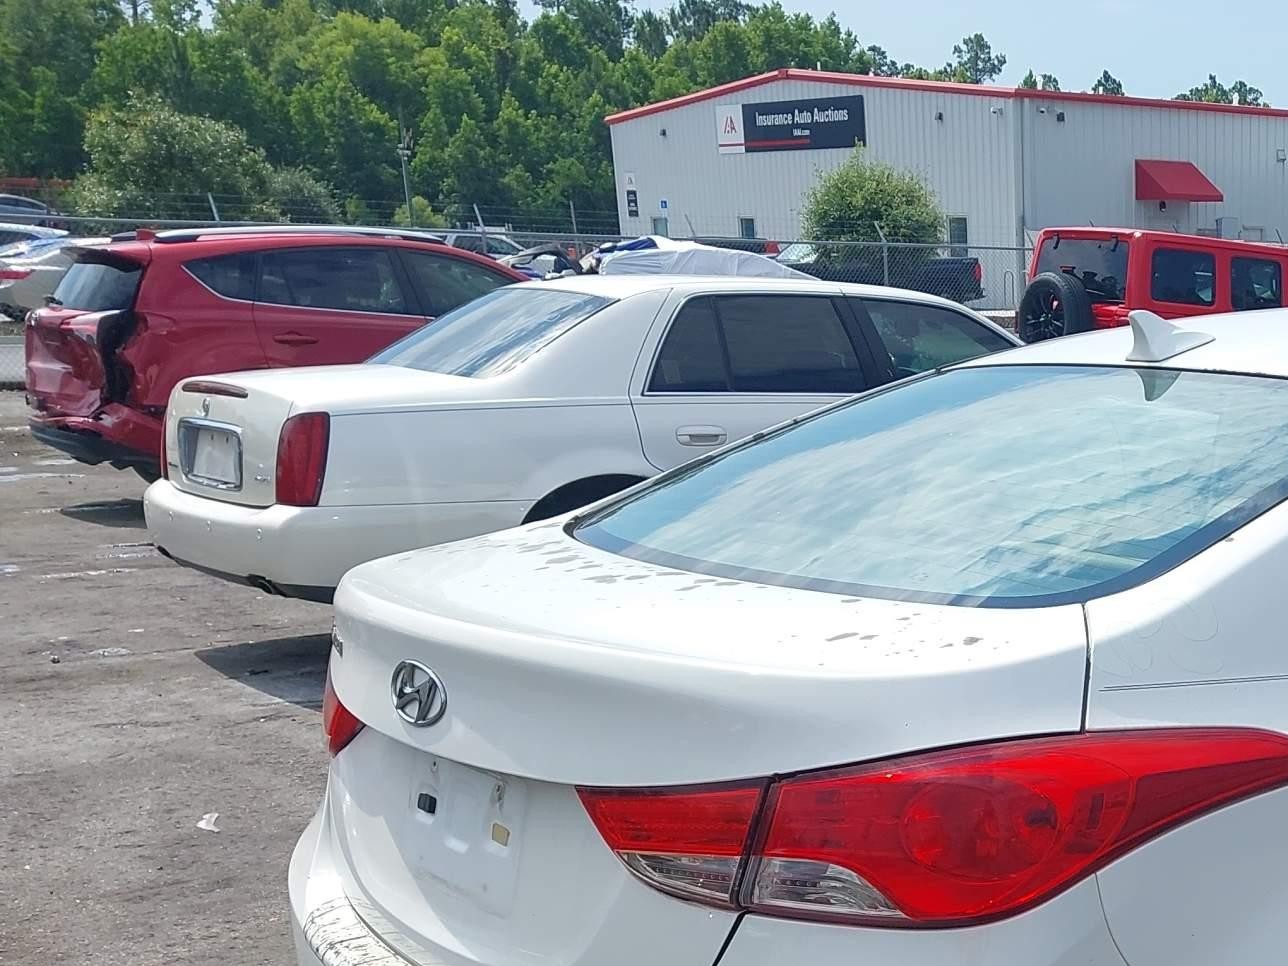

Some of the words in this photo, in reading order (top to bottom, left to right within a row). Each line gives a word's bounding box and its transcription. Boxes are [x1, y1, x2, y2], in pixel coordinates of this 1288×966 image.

[755, 111, 793, 126] Insurance
[794, 109, 812, 124] Auto
[813, 106, 849, 122] Auctions
